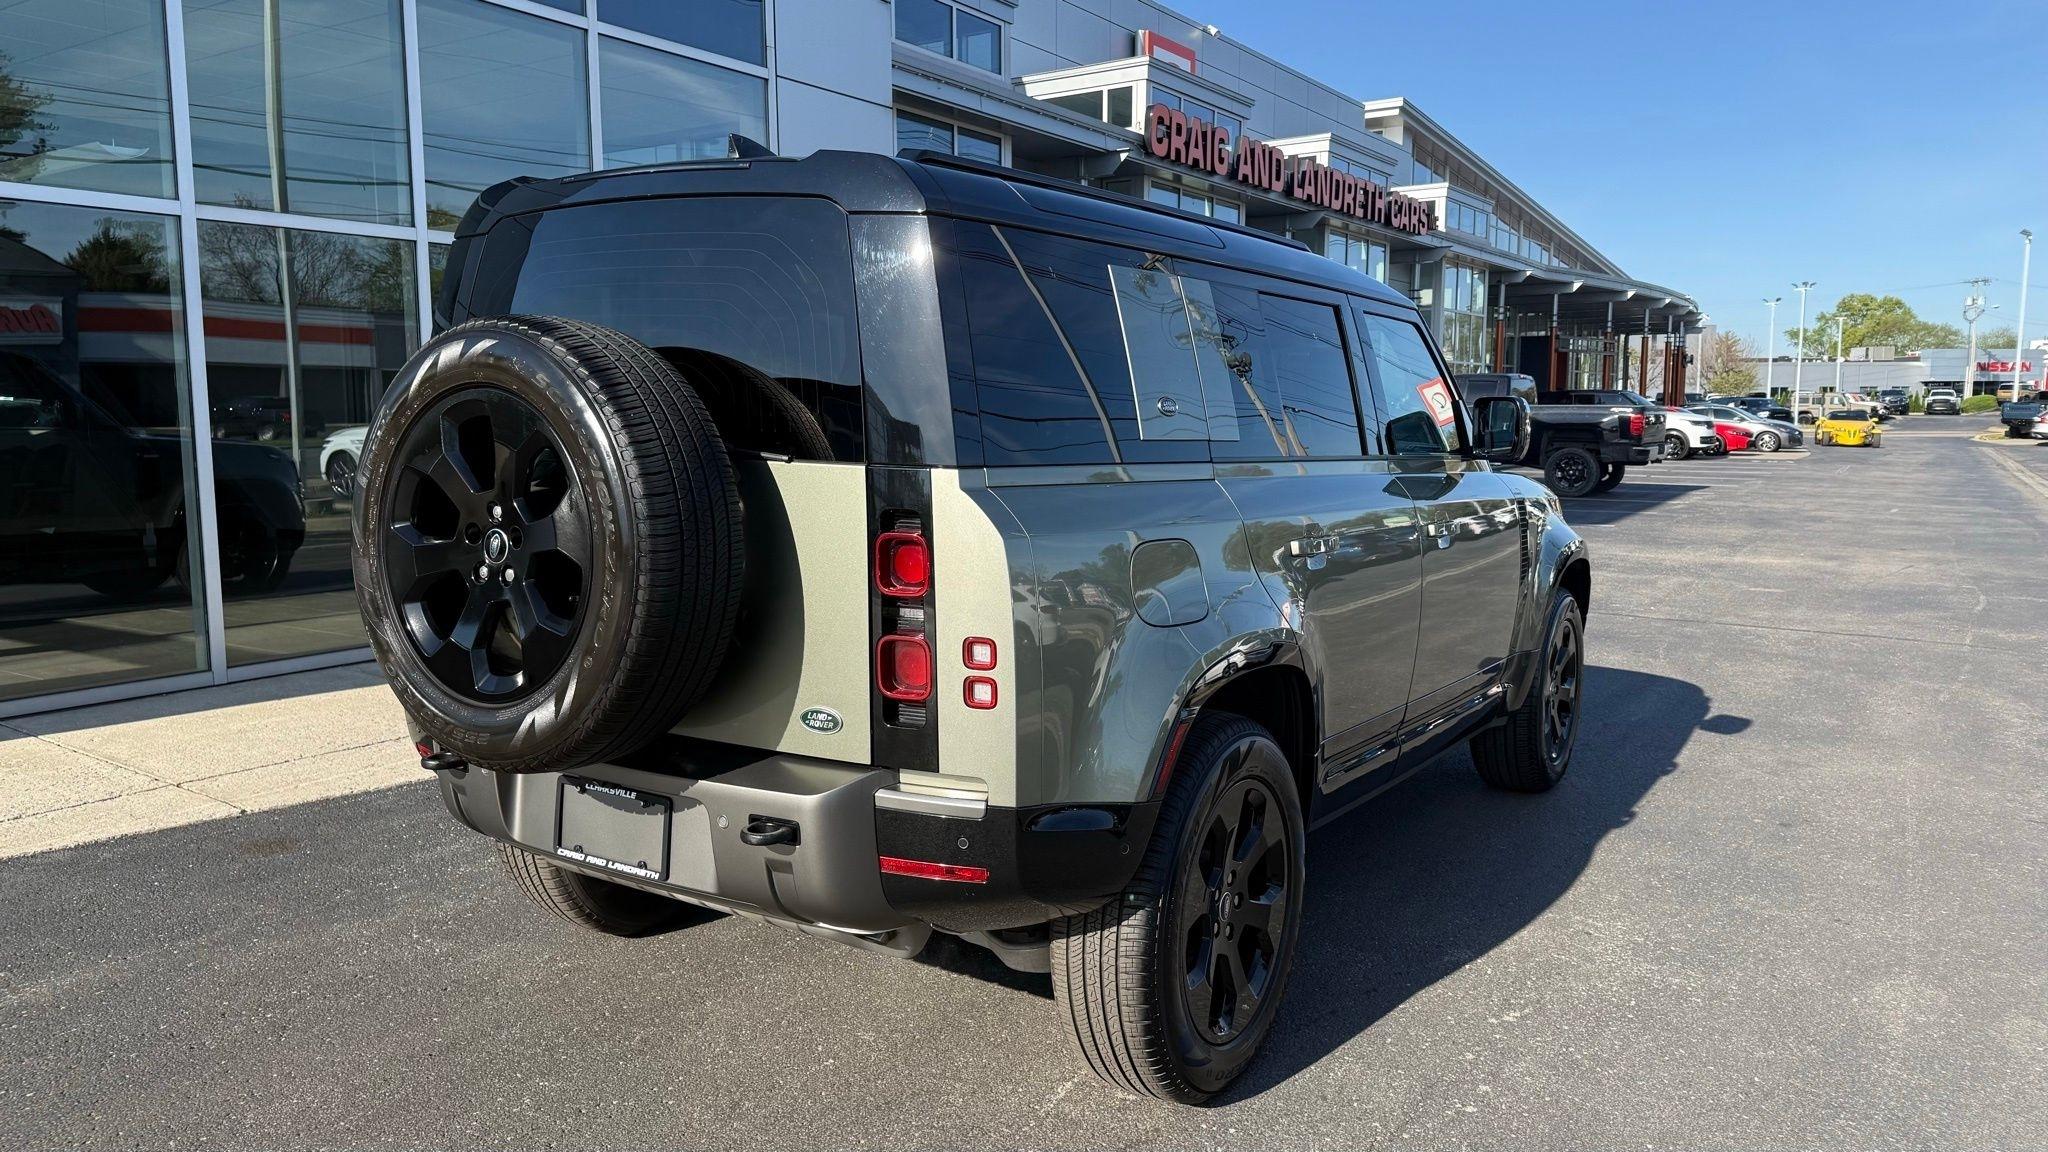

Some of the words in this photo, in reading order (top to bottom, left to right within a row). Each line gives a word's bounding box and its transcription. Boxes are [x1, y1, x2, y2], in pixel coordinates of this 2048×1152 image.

[1148, 102, 1230, 176] CRAIG
[1237, 135, 1285, 193] AND
[1292, 155, 1386, 224] LANDRETH
[1391, 190, 1428, 236] CARS
[1975, 361, 2032, 373] NISSAN
[807, 711, 828, 721] LAND
[809, 719, 834, 729] ROVER
[556, 847, 585, 861] CRAIG
[585, 855, 607, 867] AND
[607, 860, 660, 880] LANDRETH
